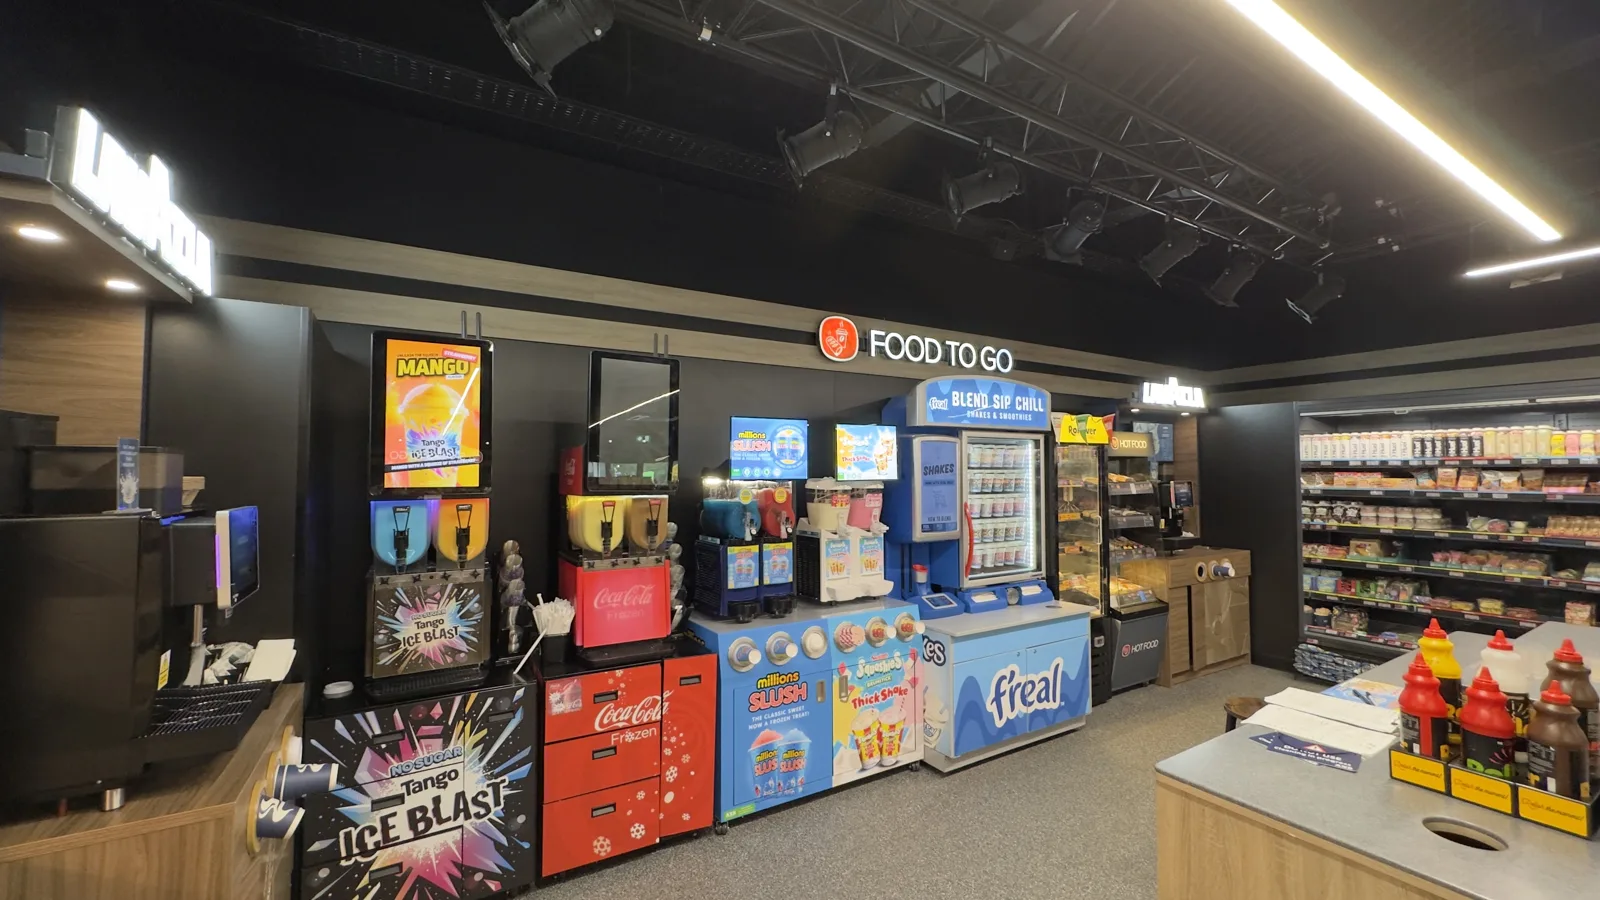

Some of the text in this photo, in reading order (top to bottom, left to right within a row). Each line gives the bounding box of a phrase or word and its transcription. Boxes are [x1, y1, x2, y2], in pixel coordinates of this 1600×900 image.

[870, 329, 1013, 373] FOOD TO GO
[396, 358, 470, 377] MANGO
[951, 391, 1044, 412] BLEND SIP CHILL
[999, 412, 1032, 421] SMOOTHIES
[421, 439, 445, 447] Tango
[1119, 440, 1147, 449] HOT FOOD
[411, 447, 457, 459] ICE BLAST
[923, 463, 955, 476] SHAKES
[414, 618, 445, 630] Tango
[607, 609, 645, 621] Frozen
[402, 625, 460, 647] ICE BLAST
[1131, 639, 1159, 654] HOT FOOD
[757, 671, 799, 689] millions
[749, 681, 808, 713] SLUSH
[851, 686, 908, 709] Thick Shake
[594, 690, 673, 732] Coca-Cola
[764, 709, 787, 719] CLASSIC
[787, 705, 805, 714] SWEET
[770, 716, 791, 724] FROZEN
[611, 726, 657, 745] Frozen
[390, 747, 463, 777] NO SUGAR
[401, 768, 459, 796] Tango
[340, 778, 507, 864] ICE BLAST
